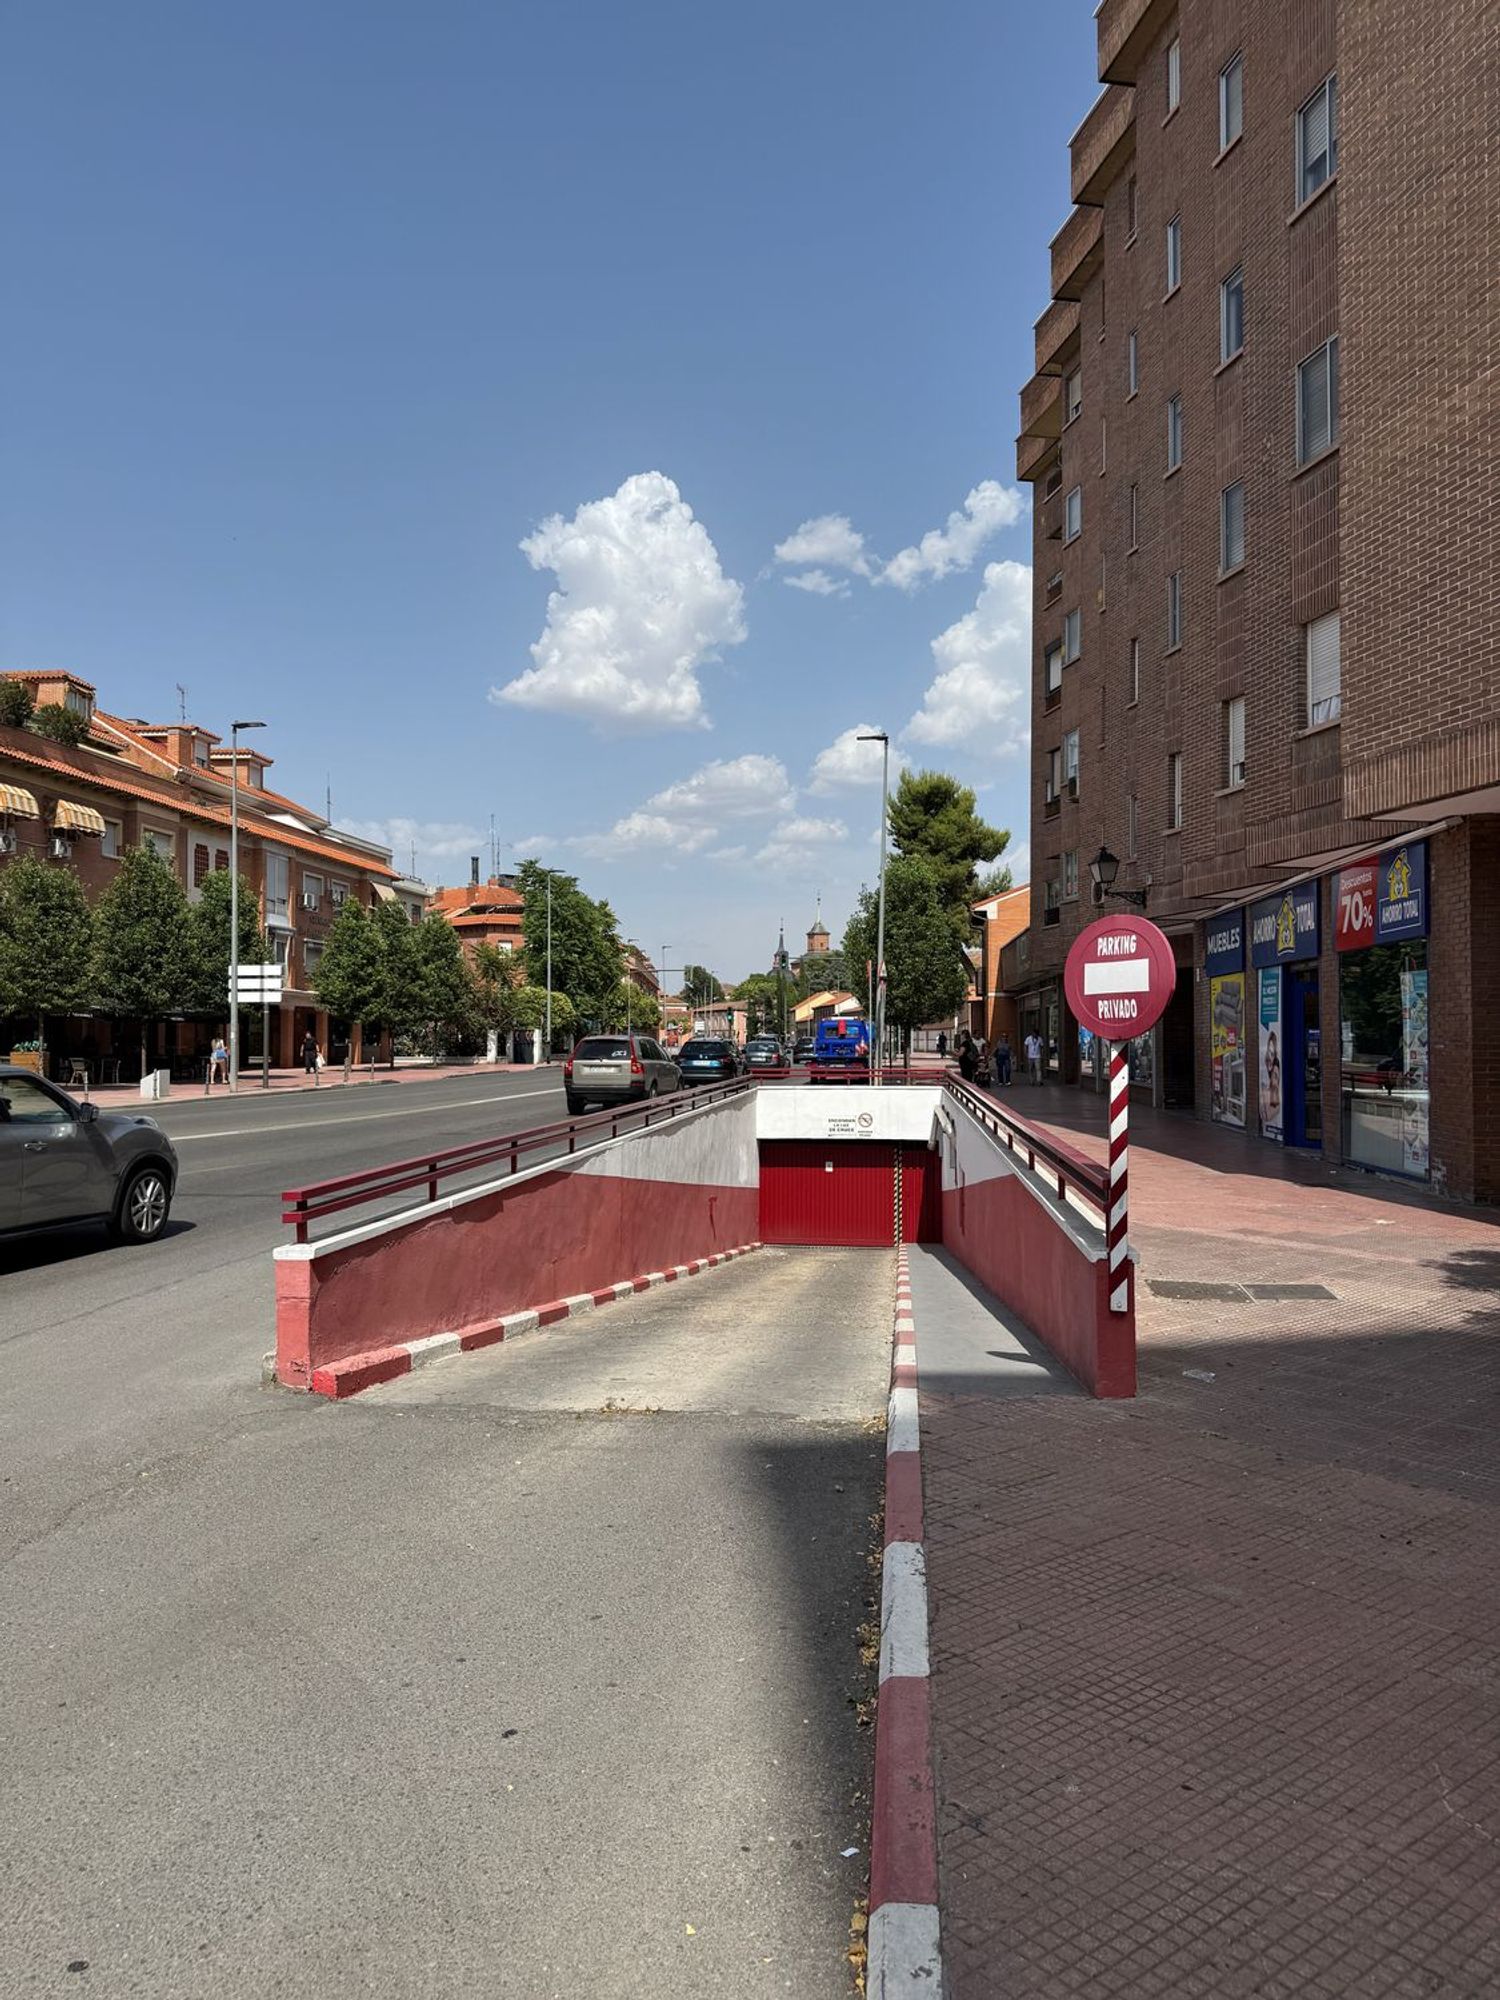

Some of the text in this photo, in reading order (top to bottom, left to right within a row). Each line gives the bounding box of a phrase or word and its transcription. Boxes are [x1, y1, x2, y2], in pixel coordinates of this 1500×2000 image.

[1253, 902, 1315, 945] AHORRO TOTAL
[1341, 891, 1373, 934] 70%
[1381, 899, 1418, 925] AHORRO TOTAL
[1097, 934, 1137, 957] PARKING
[1207, 927, 1240, 956] MUEBLES
[1097, 998, 1138, 1019] PRIVADO
